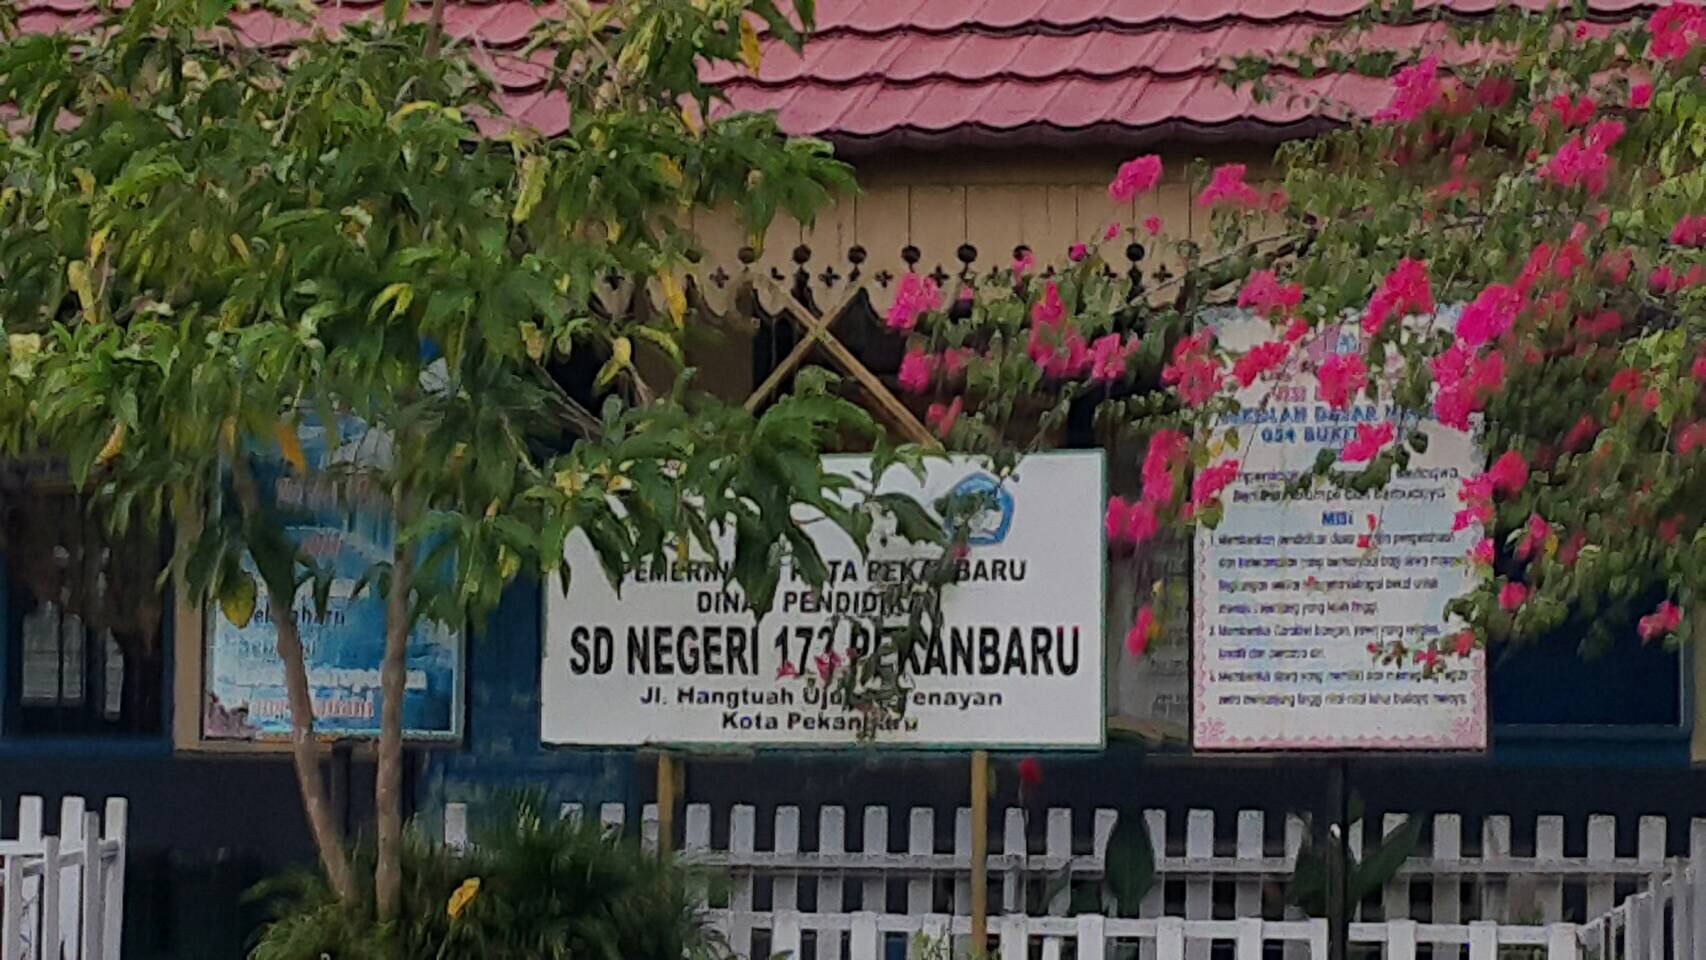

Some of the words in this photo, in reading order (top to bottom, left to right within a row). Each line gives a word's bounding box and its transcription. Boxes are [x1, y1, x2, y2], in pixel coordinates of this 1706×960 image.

[867, 560, 1026, 582] PEKBARU
[697, 590, 766, 614] DIN
[783, 590, 932, 614] PENDIDI
[570, 625, 614, 676] SD
[627, 625, 759, 676] NEGERI
[640, 687, 667, 705] Jl.
[677, 686, 793, 709] Hangtuah
[899, 687, 1003, 710] enayan
[722, 711, 778, 730] Kota
[787, 711, 918, 731] Pekanaru
